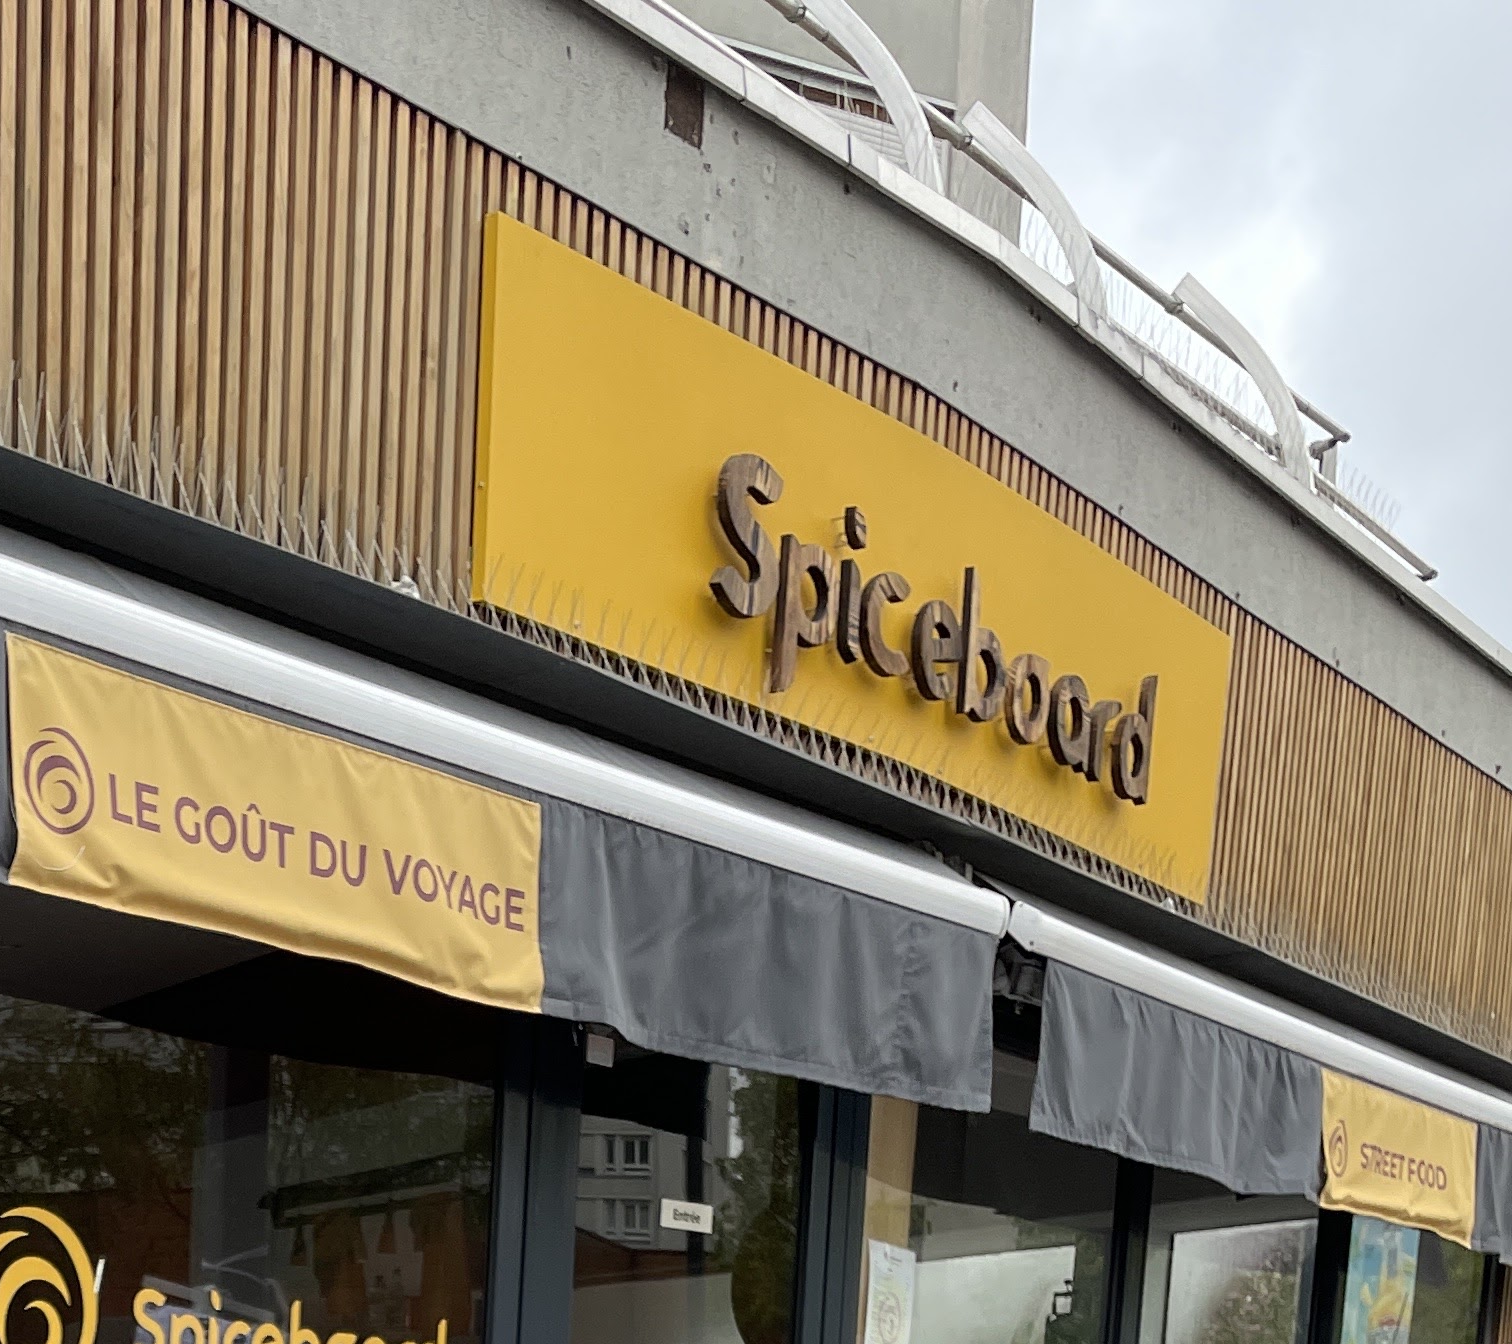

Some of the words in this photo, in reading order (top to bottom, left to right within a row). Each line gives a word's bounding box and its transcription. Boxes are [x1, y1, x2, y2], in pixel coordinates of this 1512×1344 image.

[709, 452, 1160, 806] Spiceboard
[108, 772, 161, 834] LE
[176, 797, 296, 871] GOÛT
[308, 830, 370, 888] DU
[384, 847, 528, 934] VOYAGE
[1360, 1142, 1405, 1181] STREET
[1407, 1157, 1448, 1191] FOOD
